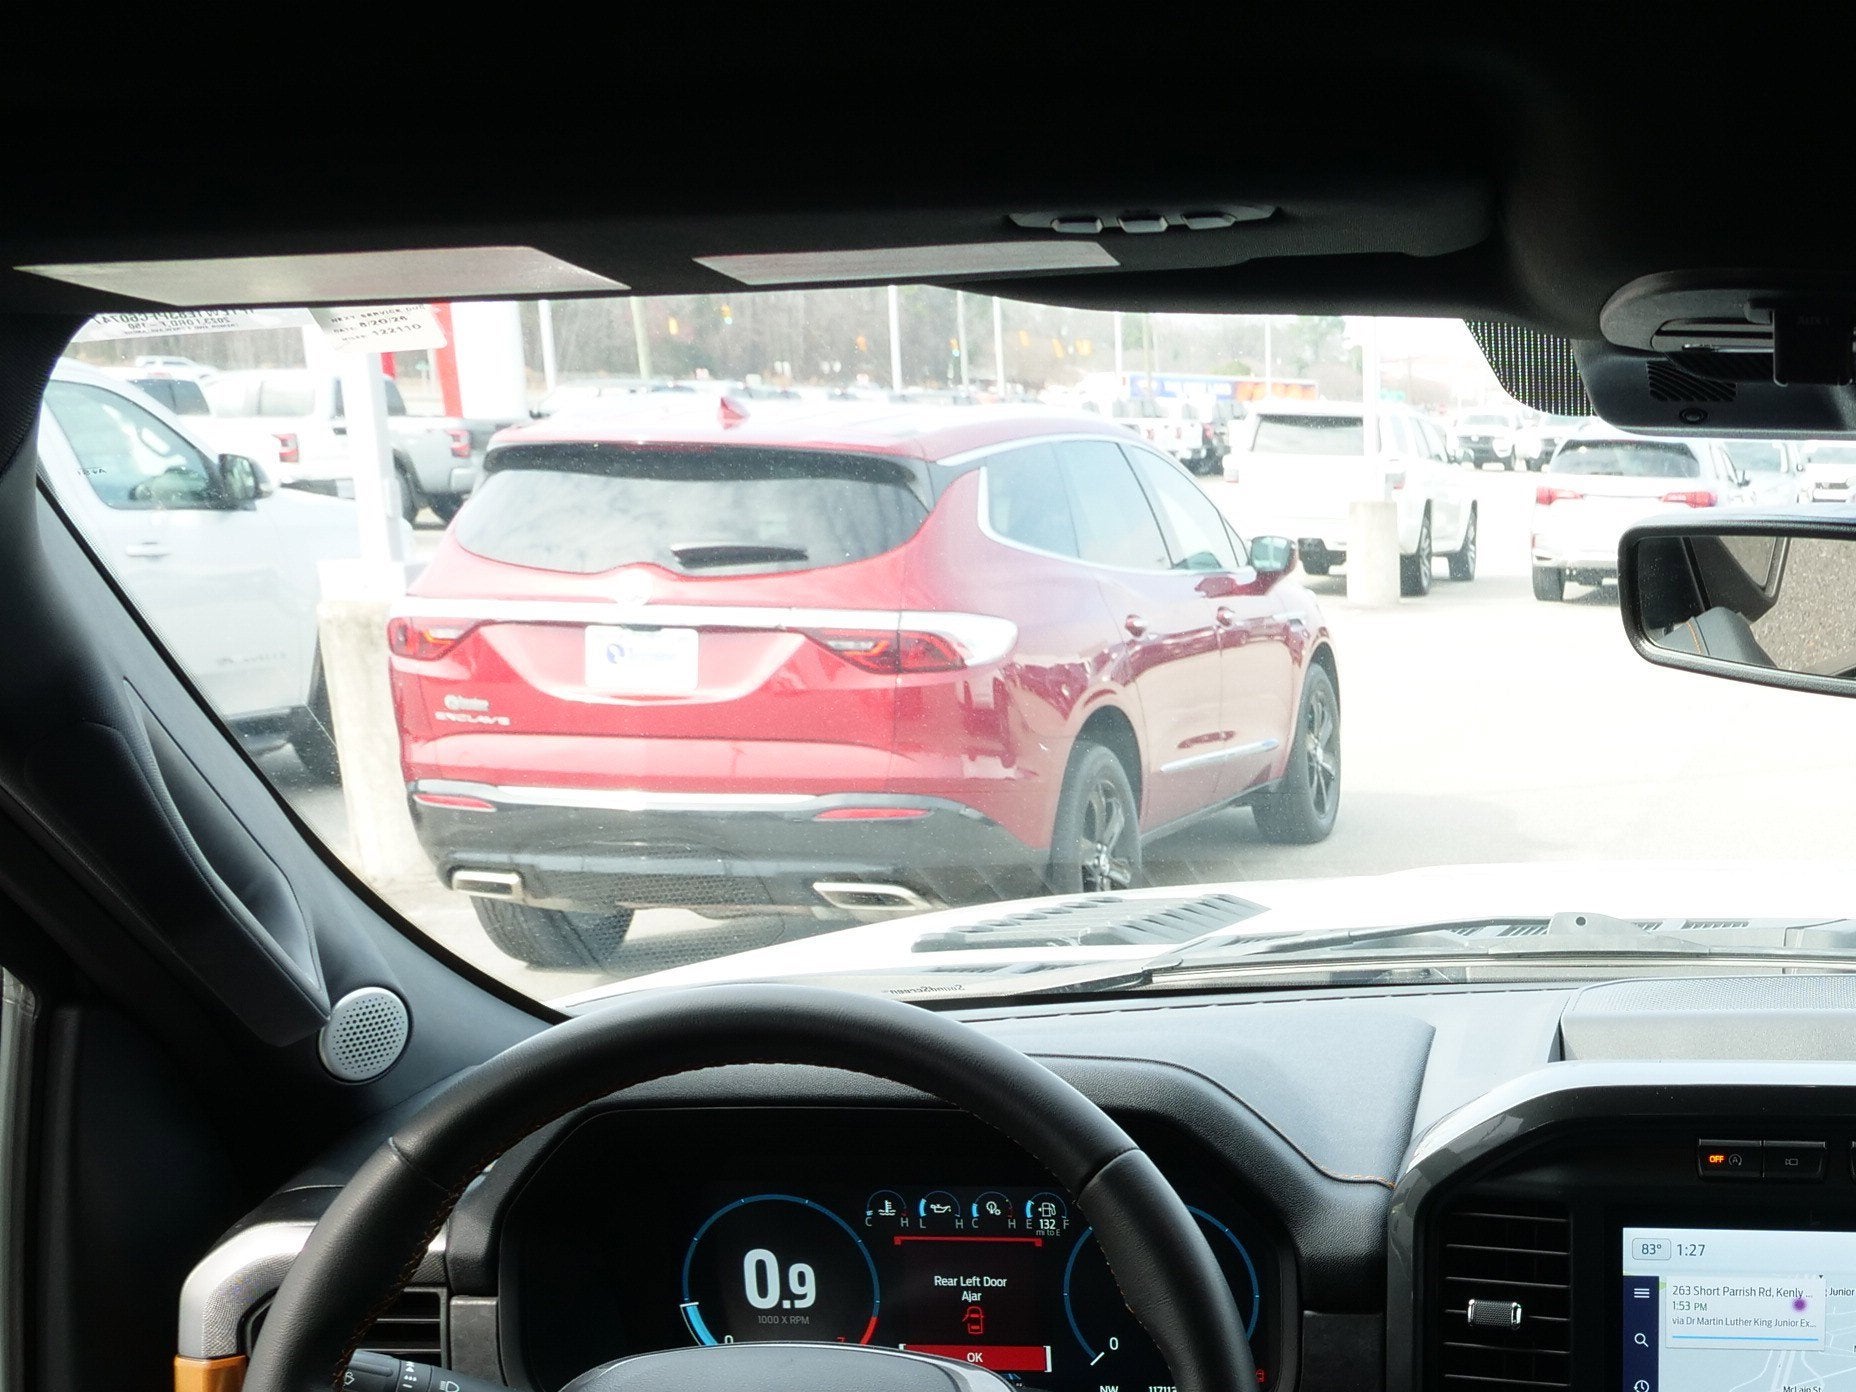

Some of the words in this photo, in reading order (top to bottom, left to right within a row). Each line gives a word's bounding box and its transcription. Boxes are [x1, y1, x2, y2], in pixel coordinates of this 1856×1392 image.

[1709, 1154, 1725, 1164] OFF
[1039, 1219, 1056, 1230] 132
[1677, 1244, 1705, 1257] 1:27
[743, 1248, 816, 1310] 0.9
[934, 1276, 957, 1287] Rear
[961, 1275, 979, 1288] Left
[983, 1276, 1007, 1288] Door
[961, 1291, 982, 1304] Ajar
[1672, 1286, 1691, 1296] 263
[1693, 1286, 1720, 1297] Short
[1723, 1286, 1756, 1297] Parrish
[1759, 1287, 1774, 1299] Rd,
[1776, 1287, 1803, 1300] Kenly
[1829, 1287, 1855, 1297] Junior
[1672, 1301, 1691, 1311] 1:53
[1694, 1303, 1707, 1312] PM
[758, 1315, 778, 1324] 1000
[789, 1315, 810, 1325] RPM
[1672, 1316, 1684, 1326] via
[1686, 1317, 1696, 1326] Dr
[1697, 1317, 1723, 1326] Martin
[1725, 1317, 1752, 1327] Luther
[1753, 1318, 1773, 1329] King
[1774, 1318, 1799, 1328] Junior
[1109, 1337, 1119, 1350] 0
[967, 1352, 983, 1363] OK
